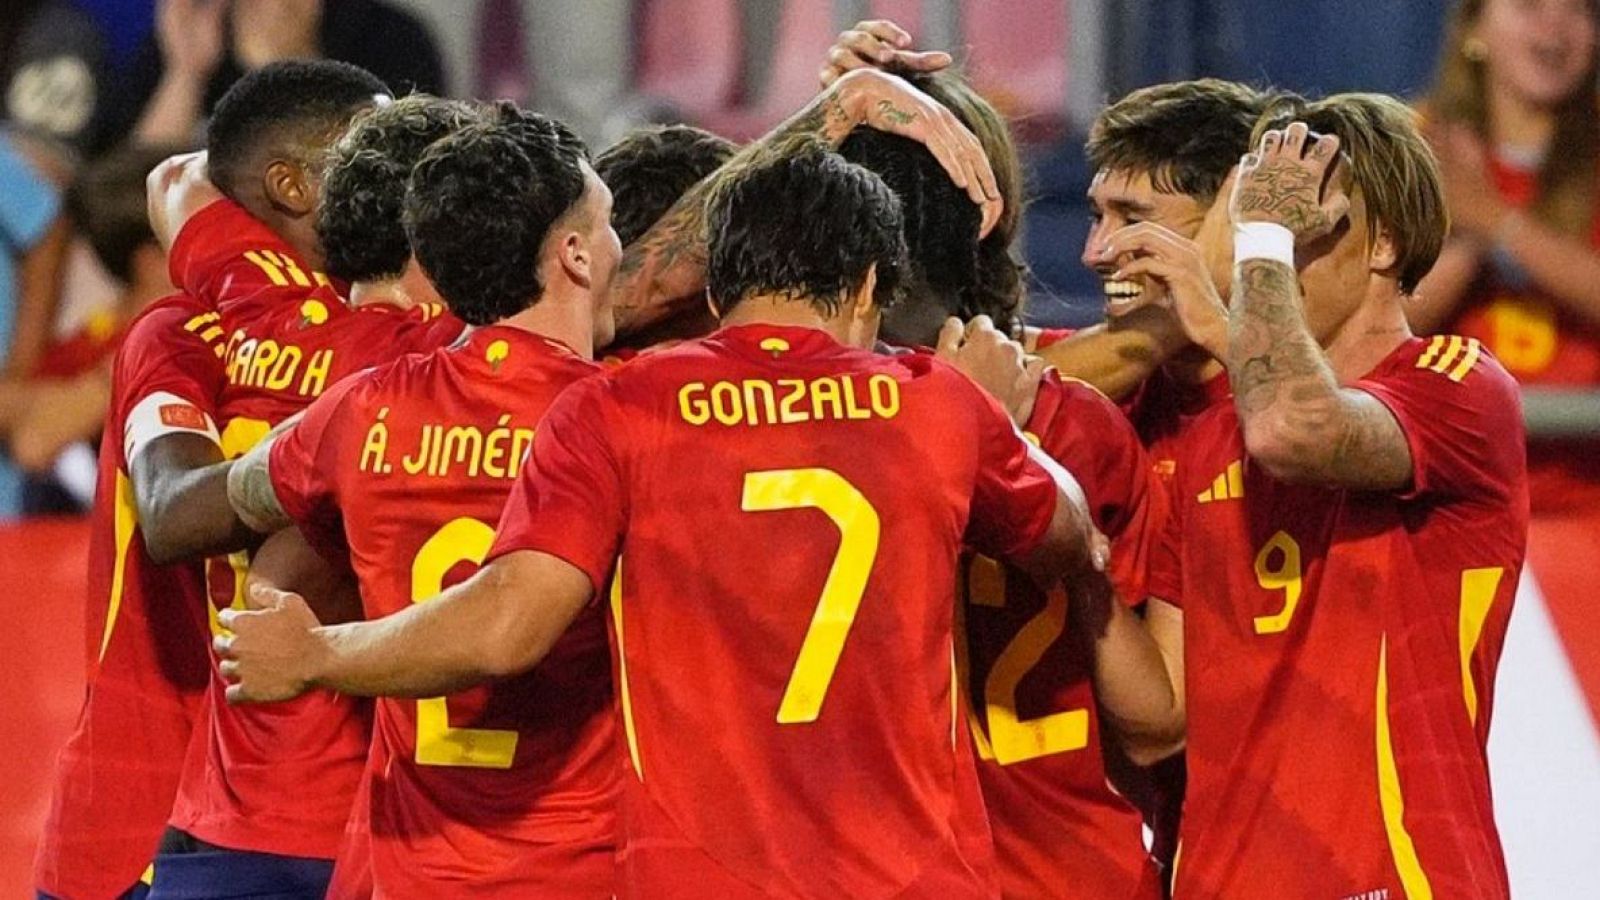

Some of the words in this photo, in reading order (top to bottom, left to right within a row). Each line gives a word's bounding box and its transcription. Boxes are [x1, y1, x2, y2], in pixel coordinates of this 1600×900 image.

[299, 349, 334, 397] H
[678, 374, 900, 426] GONZALO
[360, 407, 392, 473] Á.
[741, 468, 880, 723] 7
[1254, 530, 1301, 634] 9
